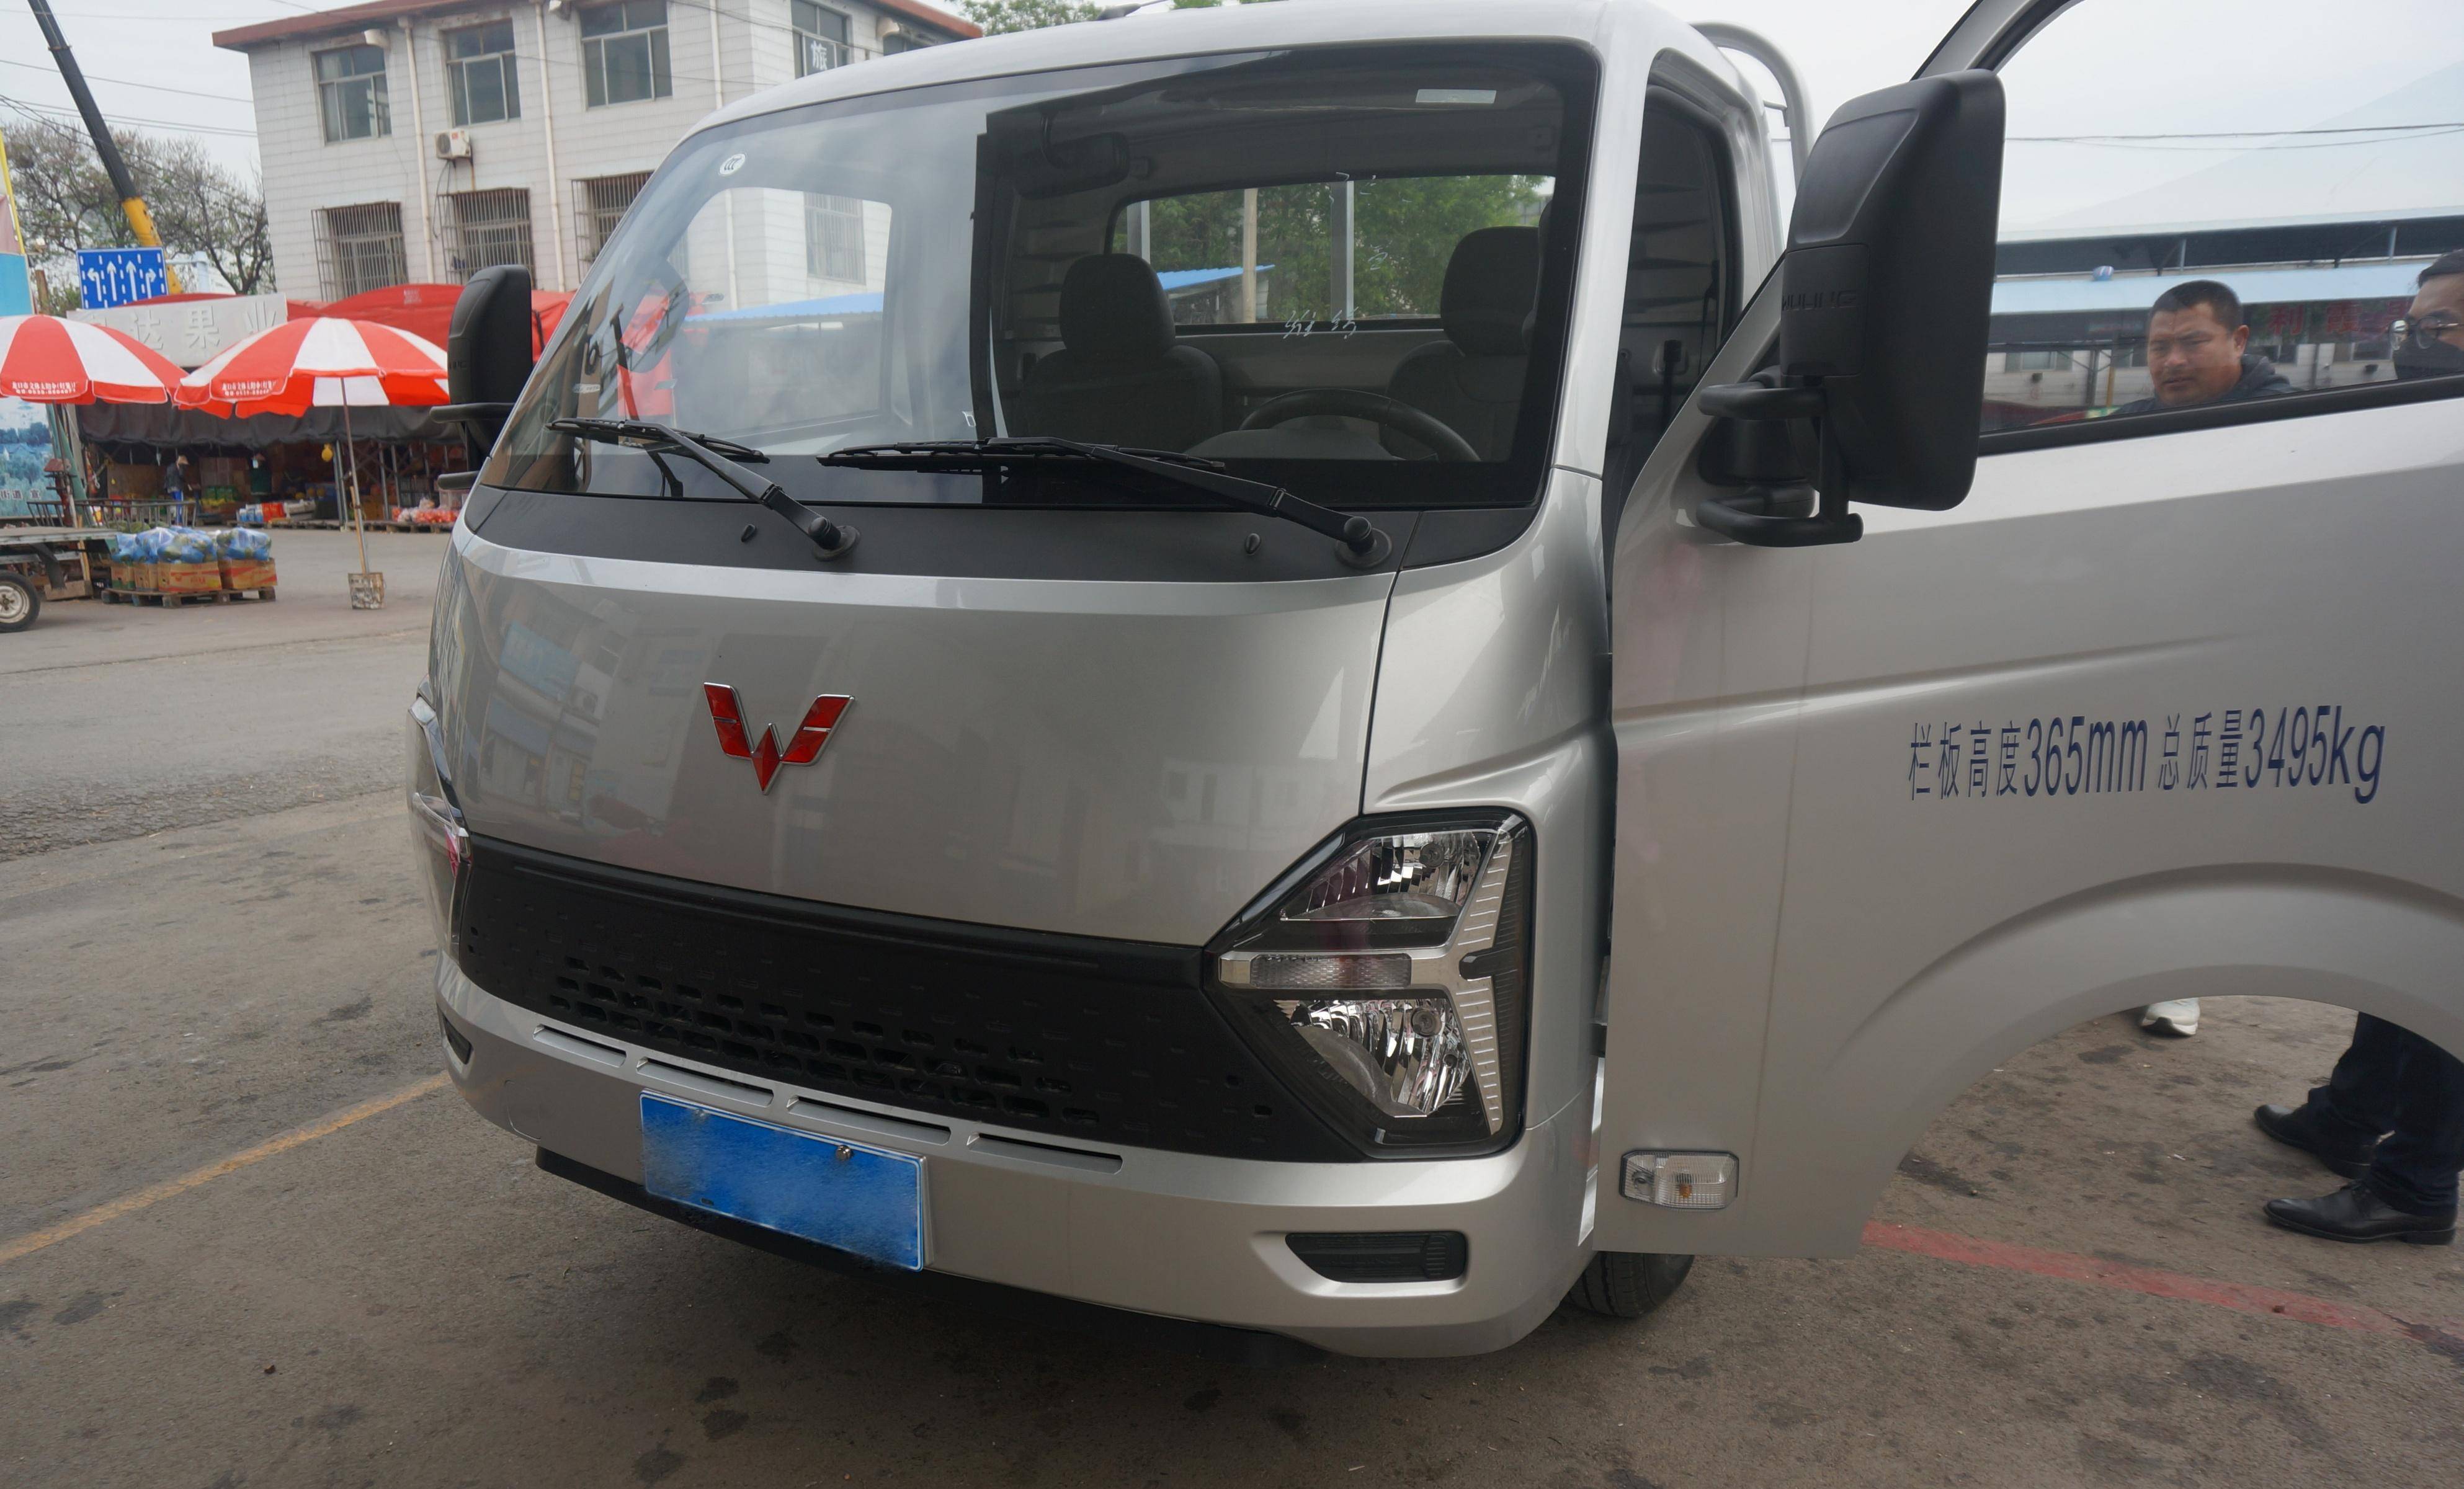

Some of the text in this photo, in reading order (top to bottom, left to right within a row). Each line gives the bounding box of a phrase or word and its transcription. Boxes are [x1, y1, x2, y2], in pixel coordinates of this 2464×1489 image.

[810, 40, 828, 70] 旅
[1909, 704, 2386, 804] 栏板高度365mm 总质量3495kg
